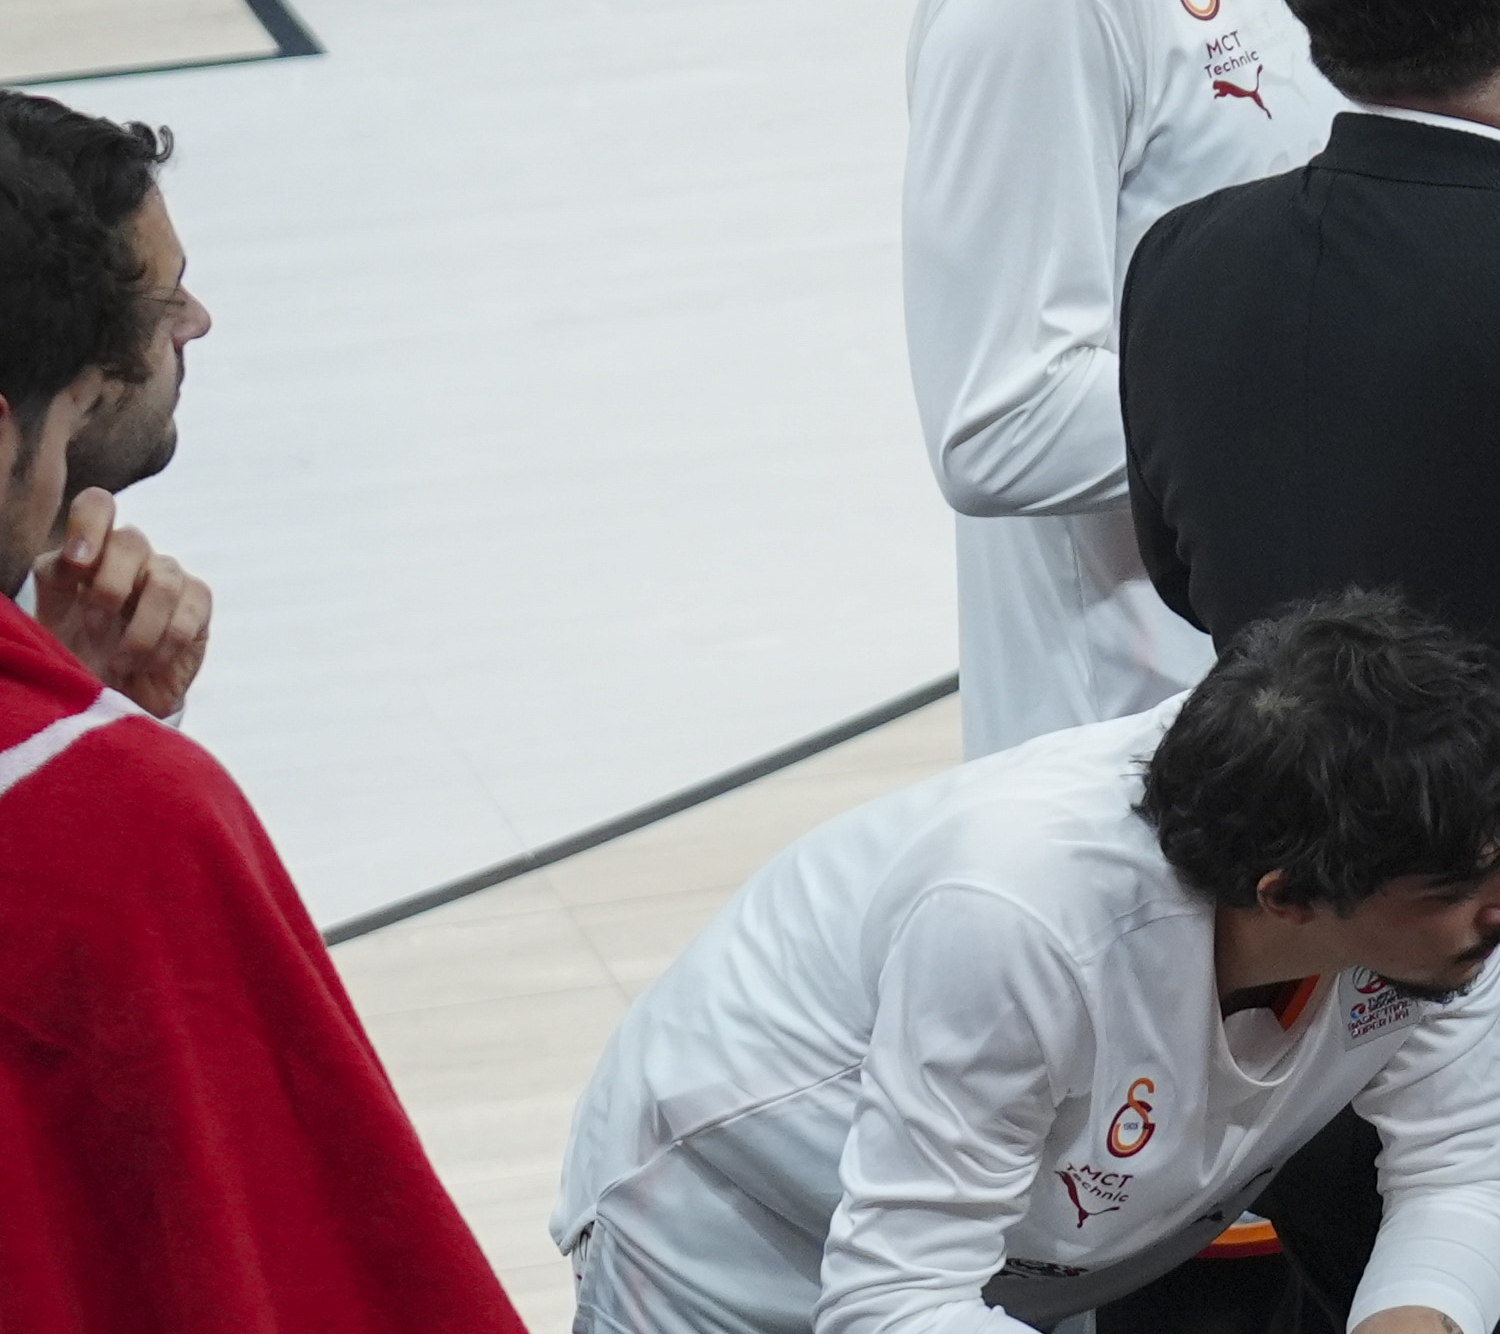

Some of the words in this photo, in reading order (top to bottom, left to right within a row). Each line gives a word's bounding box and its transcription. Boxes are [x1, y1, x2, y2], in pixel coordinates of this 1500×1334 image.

[1206, 31, 1241, 59] MCT
[1204, 50, 1259, 78] Technic
[1066, 1162, 1130, 1202] Technic
[1081, 1164, 1134, 1189] MCT
